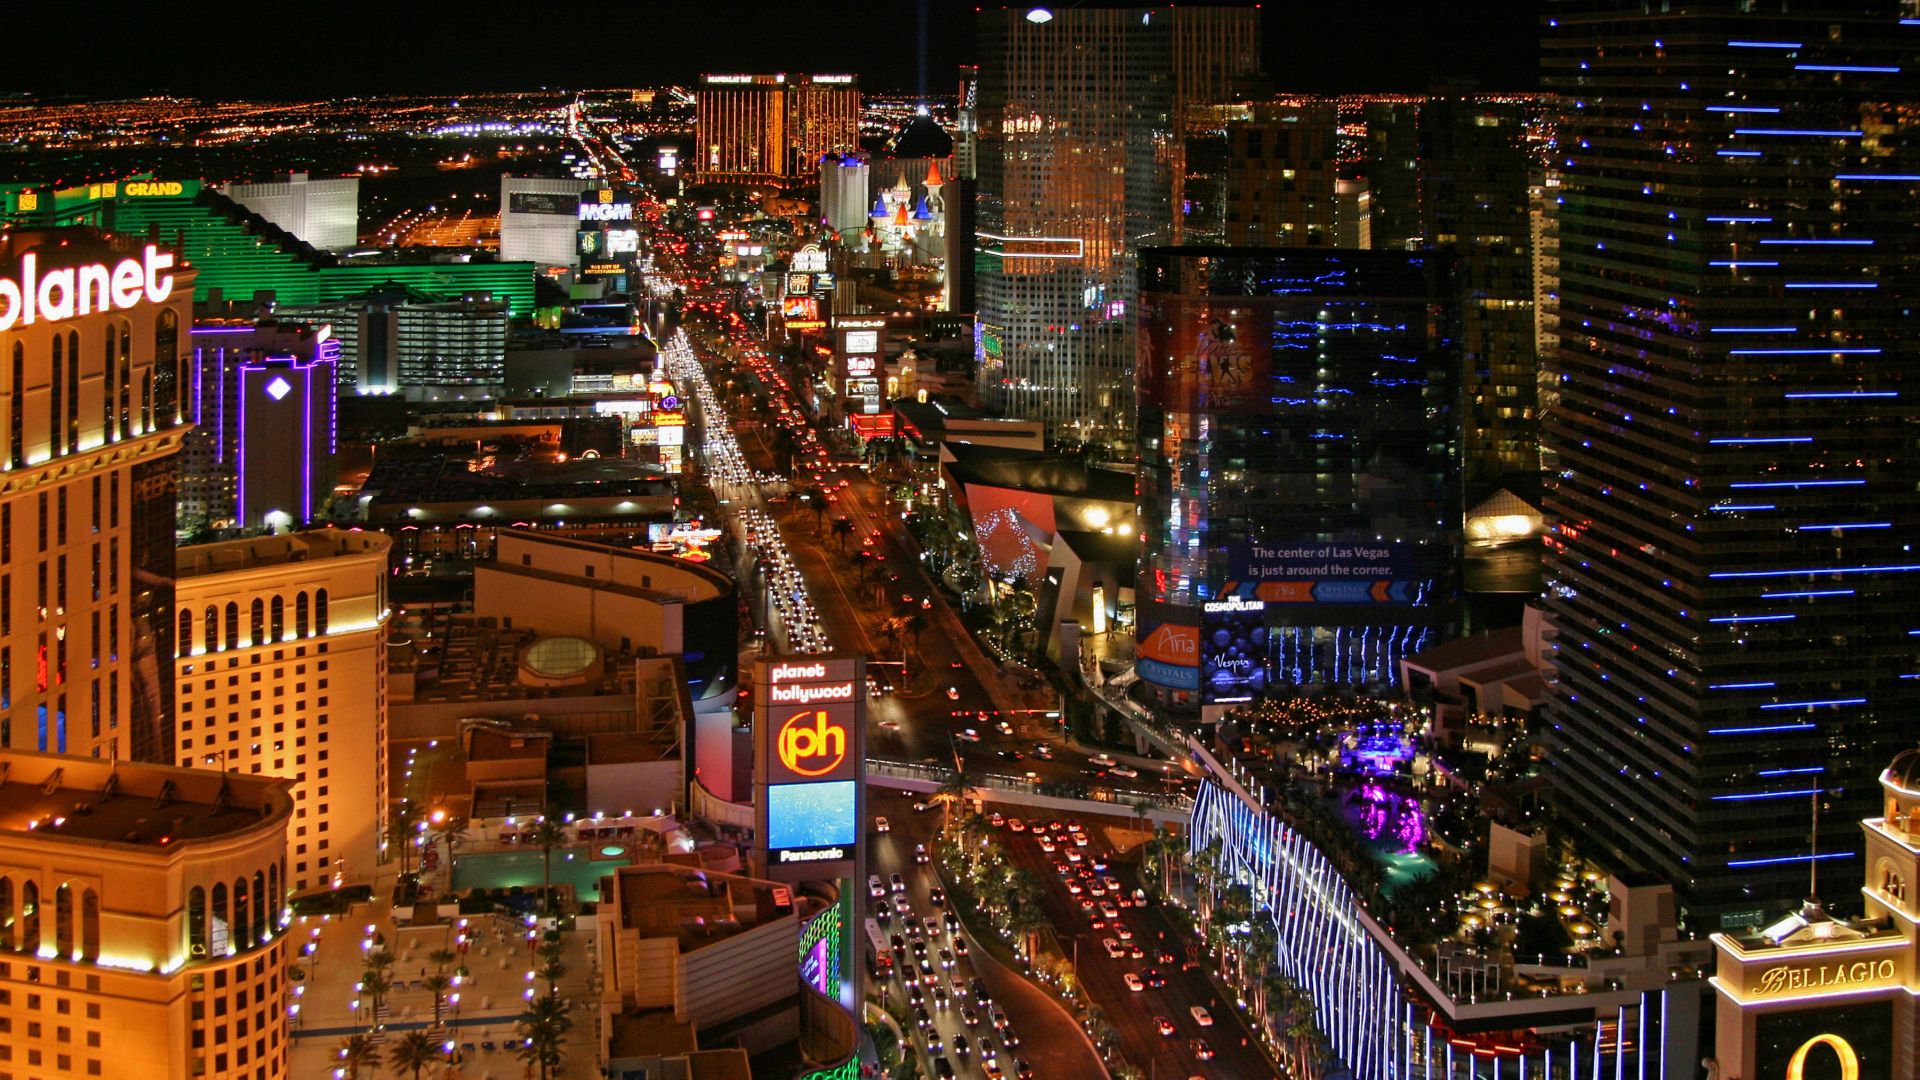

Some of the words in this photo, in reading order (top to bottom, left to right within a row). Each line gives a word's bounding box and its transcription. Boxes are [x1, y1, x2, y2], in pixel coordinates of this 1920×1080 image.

[125, 182, 183, 196] GRAND
[579, 203, 632, 221] MGM
[1251, 547, 1275, 558] The
[1277, 548, 1315, 558] center
[1317, 547, 1330, 558] of
[1333, 547, 1352, 558] Las
[1353, 547, 1390, 560] Vegas
[1248, 565, 1258, 576] is
[1260, 565, 1284, 578] just
[1286, 565, 1328, 576] around
[1330, 565, 1350, 575] the
[1352, 566, 1393, 575] corner.
[1204, 600, 1264, 612] COSMOPOLITAN
[1158, 626, 1195, 653] Aria
[772, 663, 825, 683] planet
[1144, 661, 1193, 680] CRYSTALS
[772, 683, 852, 703] hollywood
[787, 711, 845, 767] ph
[780, 847, 844, 862] Panasonic
[1752, 959, 1896, 995] BELLAGIO
